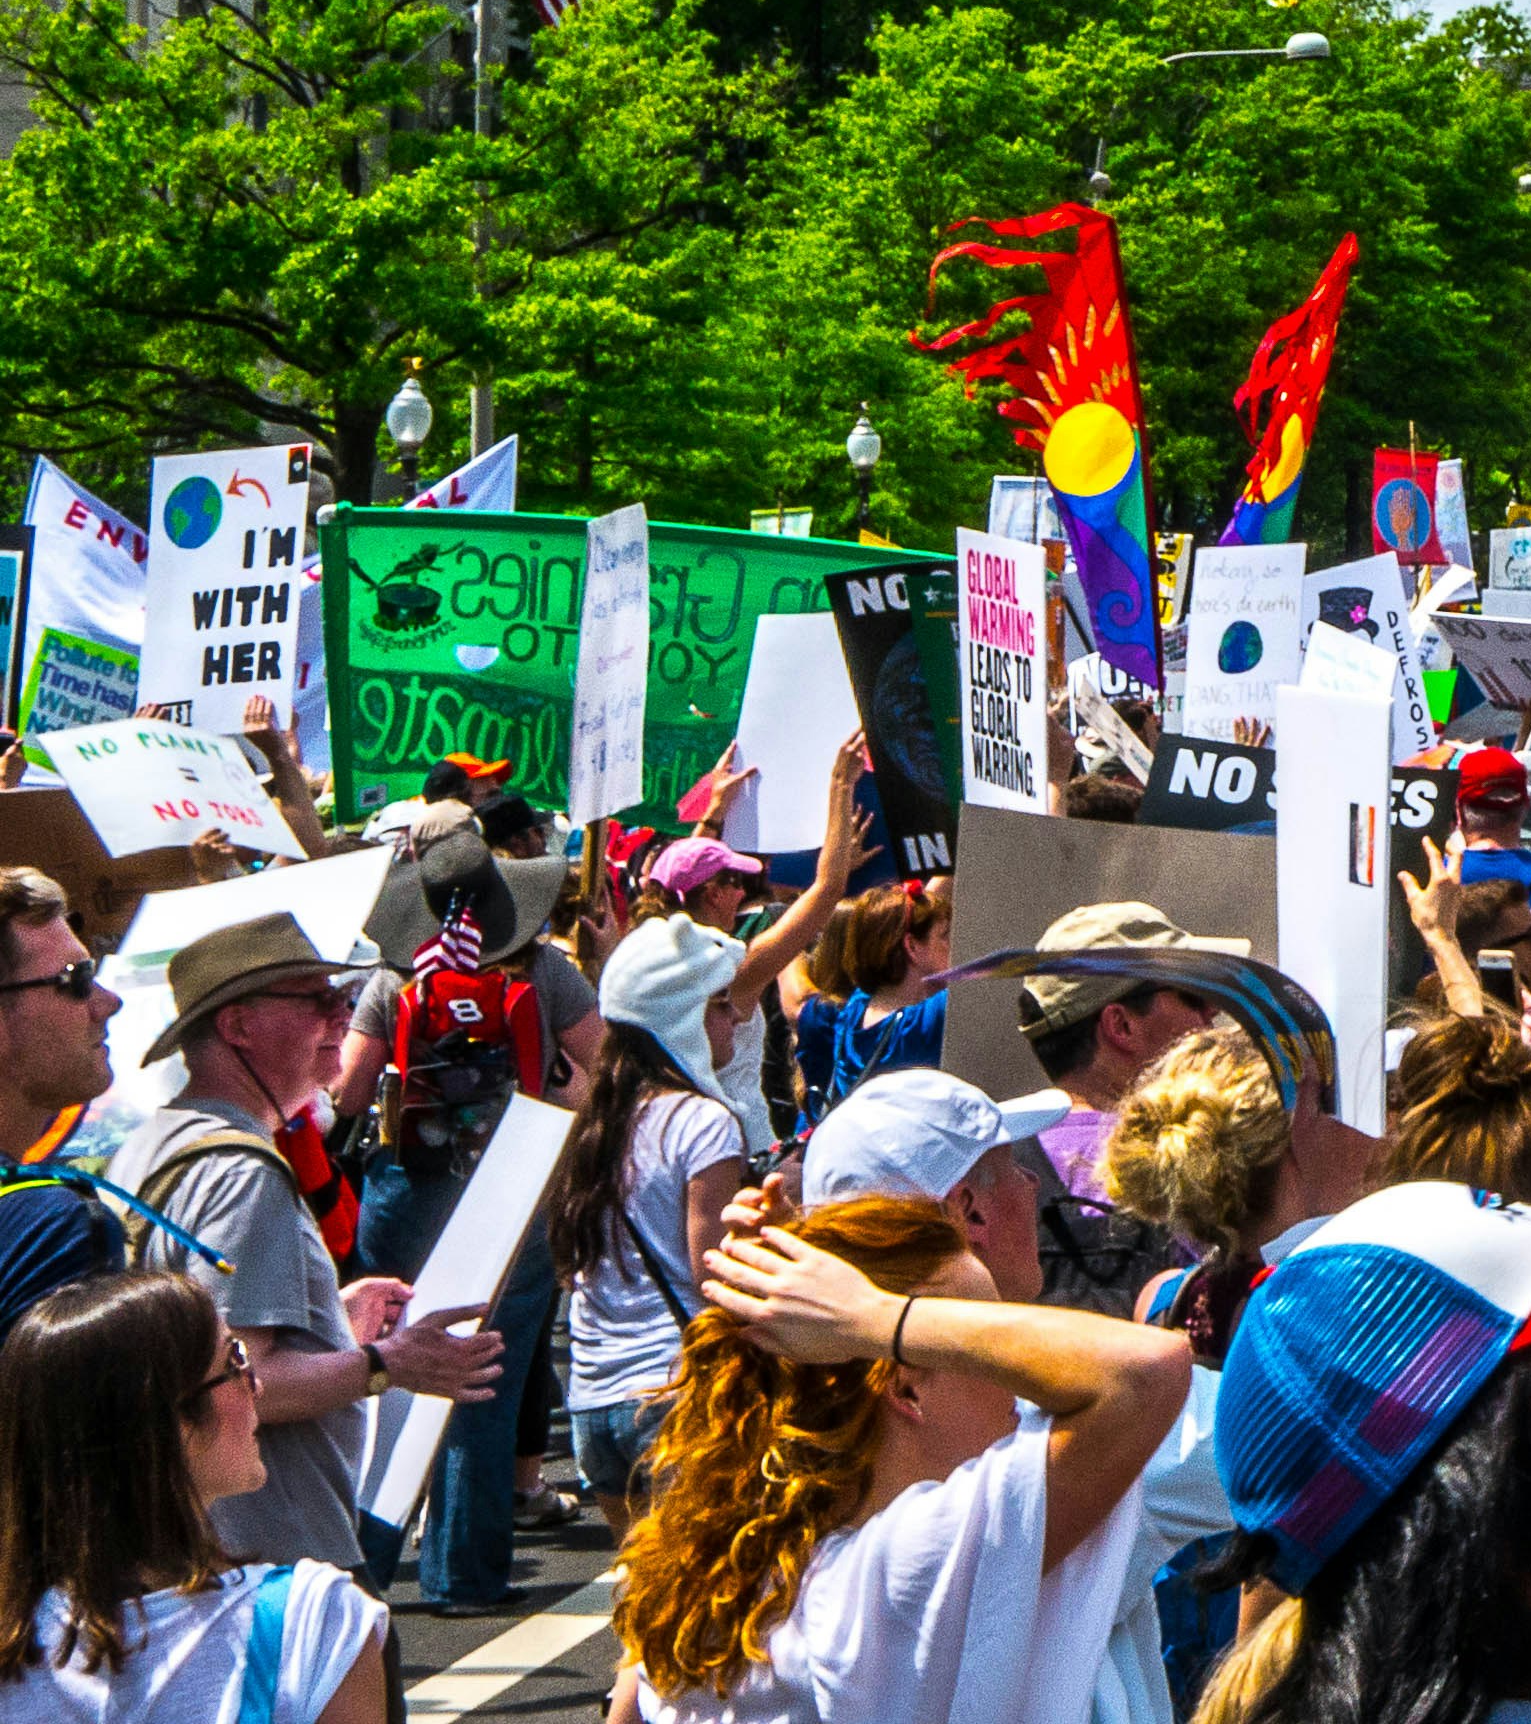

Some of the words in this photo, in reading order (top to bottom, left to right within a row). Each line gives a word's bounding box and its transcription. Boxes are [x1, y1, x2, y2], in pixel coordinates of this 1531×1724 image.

[242, 526, 297, 569] I'M
[967, 548, 1020, 606] GLOBAL
[192, 582, 290, 631] WITH
[968, 595, 1036, 658] WARMING
[40, 661, 92, 696] Time
[92, 678, 130, 713] has
[202, 641, 281, 687] HER
[969, 642, 1013, 697] LEADS
[1014, 654, 1032, 704] TO
[1386, 610, 1432, 752] DEFROS
[971, 688, 1021, 747] GLOBAL
[76, 737, 119, 762] NO
[136, 731, 225, 760] PLANET
[971, 733, 1037, 799] WARRING.
[1168, 746, 1258, 805] NO
[151, 798, 201, 823] NO
[903, 832, 952, 873] IN
[448, 999, 483, 1023] 8
